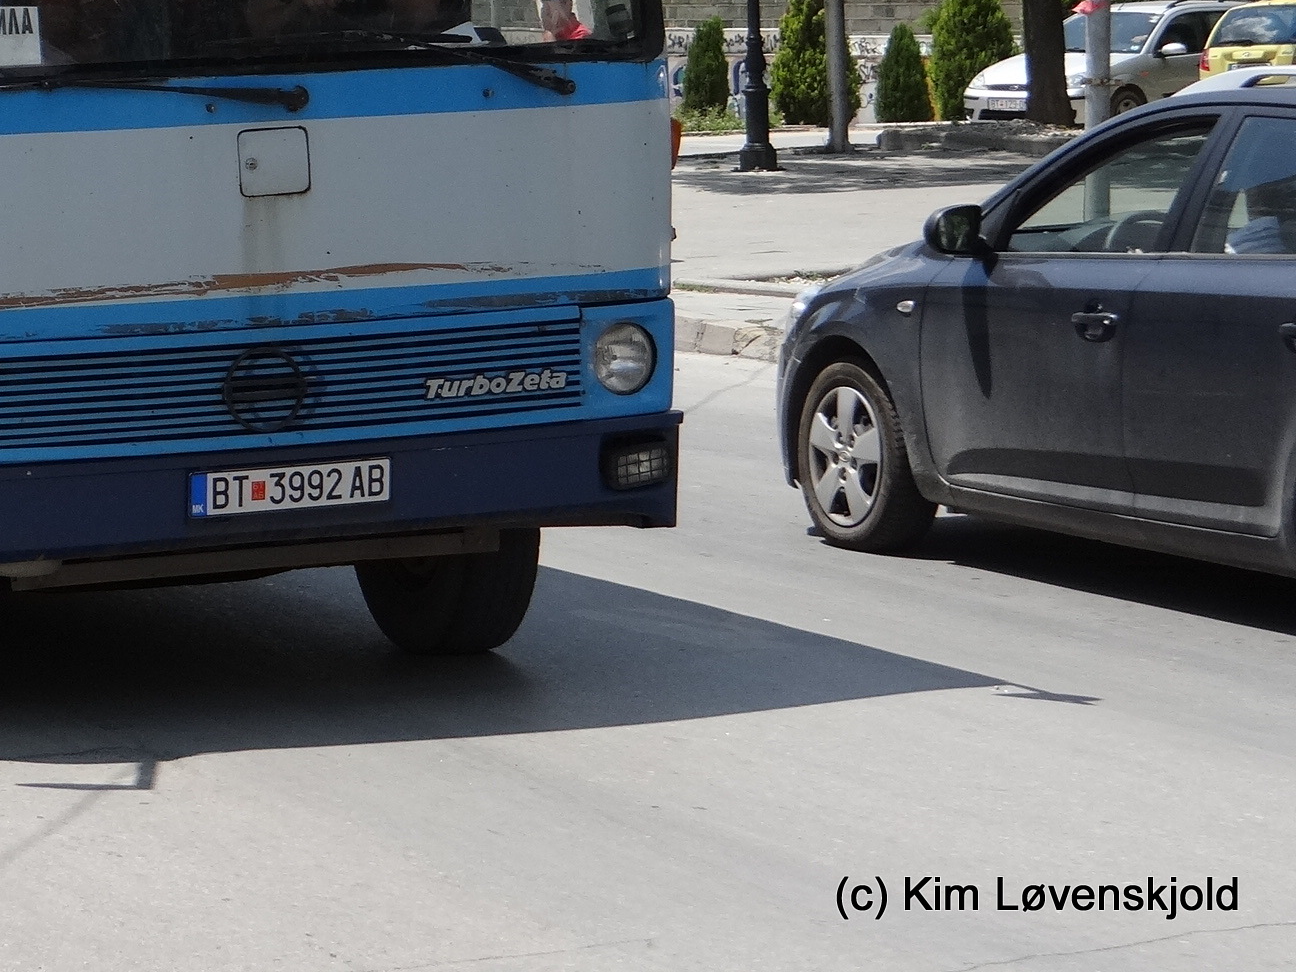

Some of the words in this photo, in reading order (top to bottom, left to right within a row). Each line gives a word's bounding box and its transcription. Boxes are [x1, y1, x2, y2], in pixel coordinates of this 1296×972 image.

[425, 368, 568, 399] TurboZeta
[212, 474, 249, 510] BT
[192, 504, 205, 514] MK
